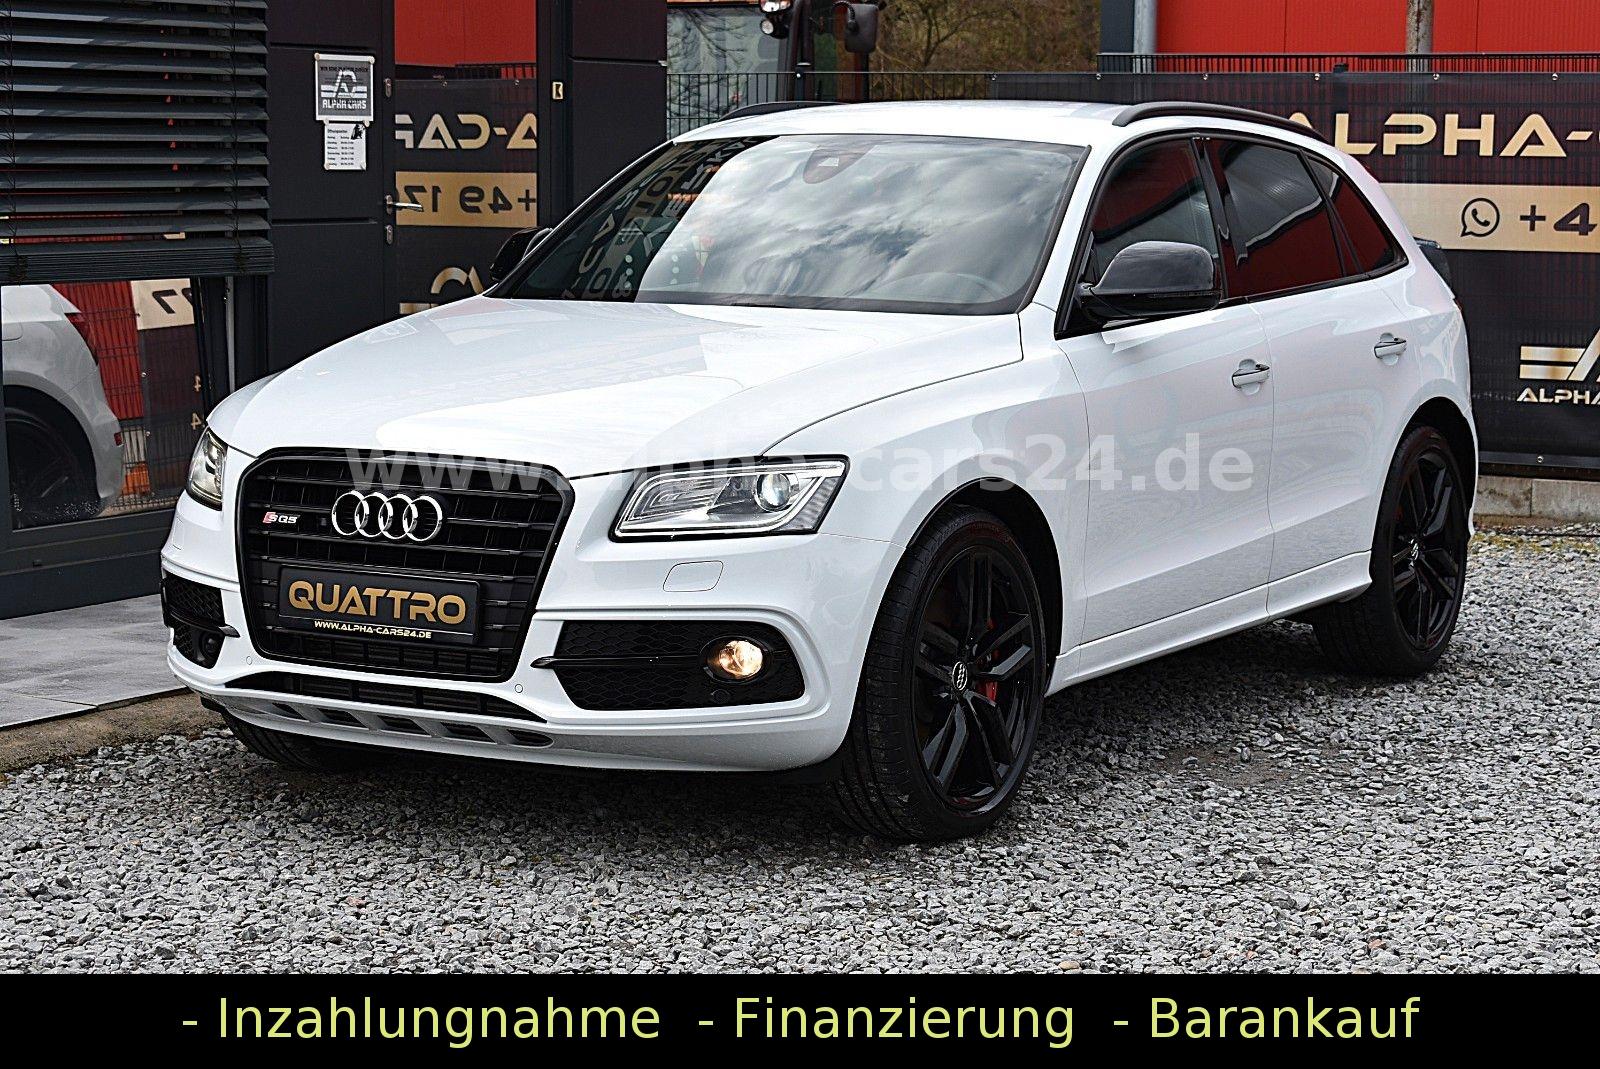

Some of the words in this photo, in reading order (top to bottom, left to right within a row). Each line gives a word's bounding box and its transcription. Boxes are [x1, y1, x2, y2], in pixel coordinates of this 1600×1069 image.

[1288, 112, 1600, 157] LPHA-
[288, 580, 466, 625] QUATTRO
[313, 619, 432, 640] WWW.ALPHA-CARS24.DE
